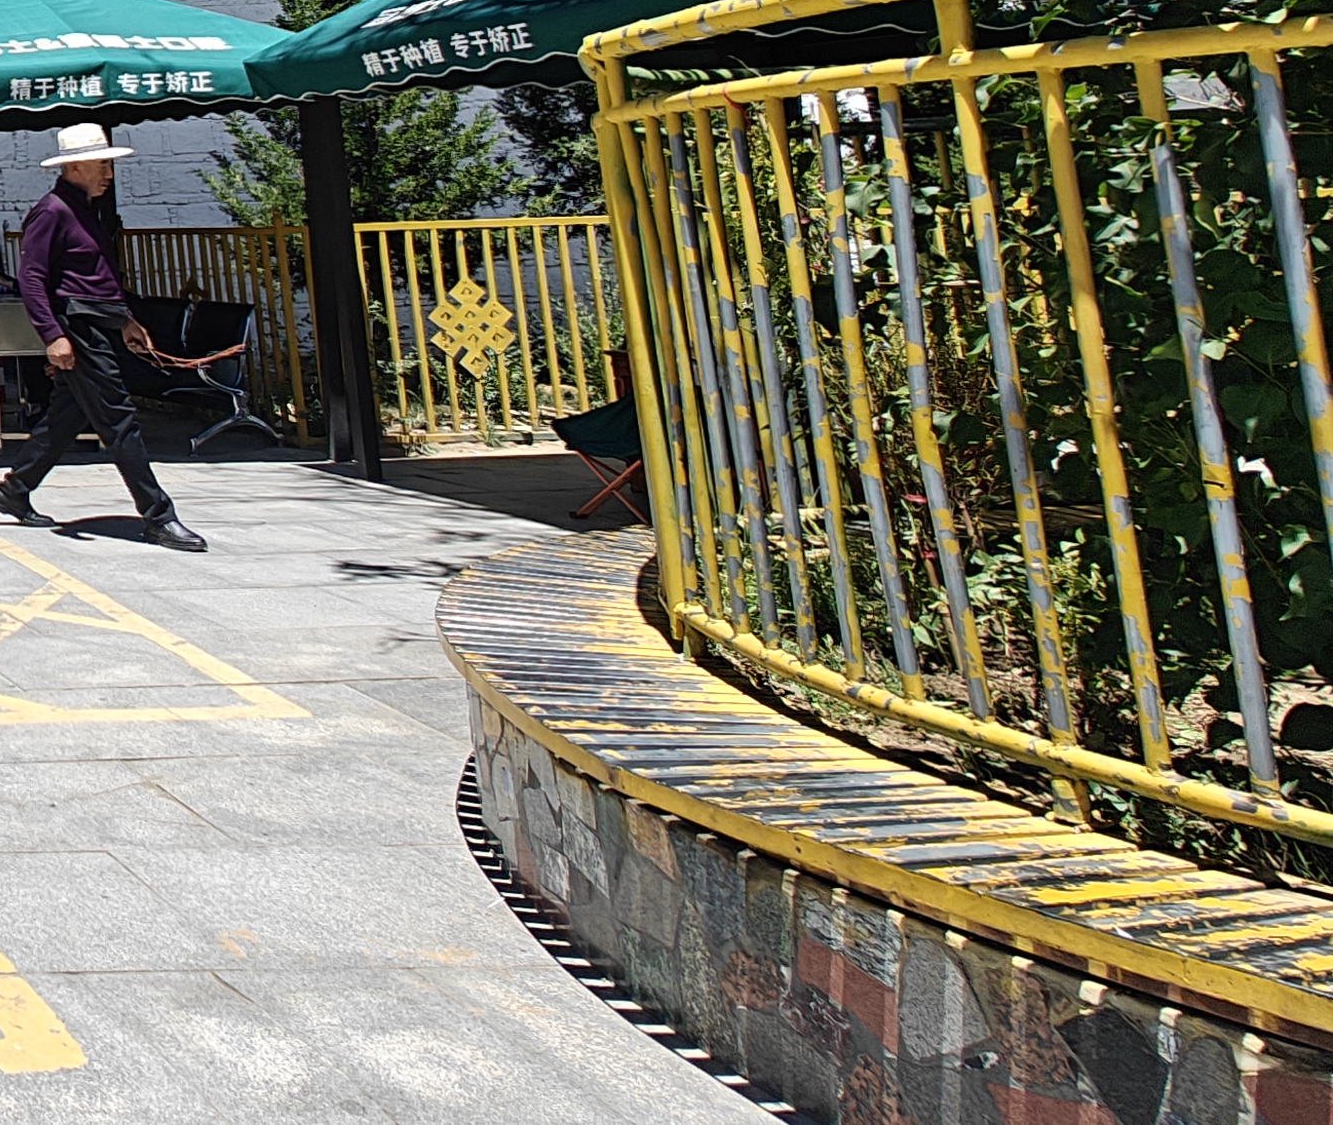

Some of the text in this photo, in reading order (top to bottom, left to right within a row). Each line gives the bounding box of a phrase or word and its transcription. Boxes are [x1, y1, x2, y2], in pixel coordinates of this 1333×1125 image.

[361, 22, 534, 79] 精于种植 专于矫正
[9, 70, 215, 101] 精于种植 专于矫正
